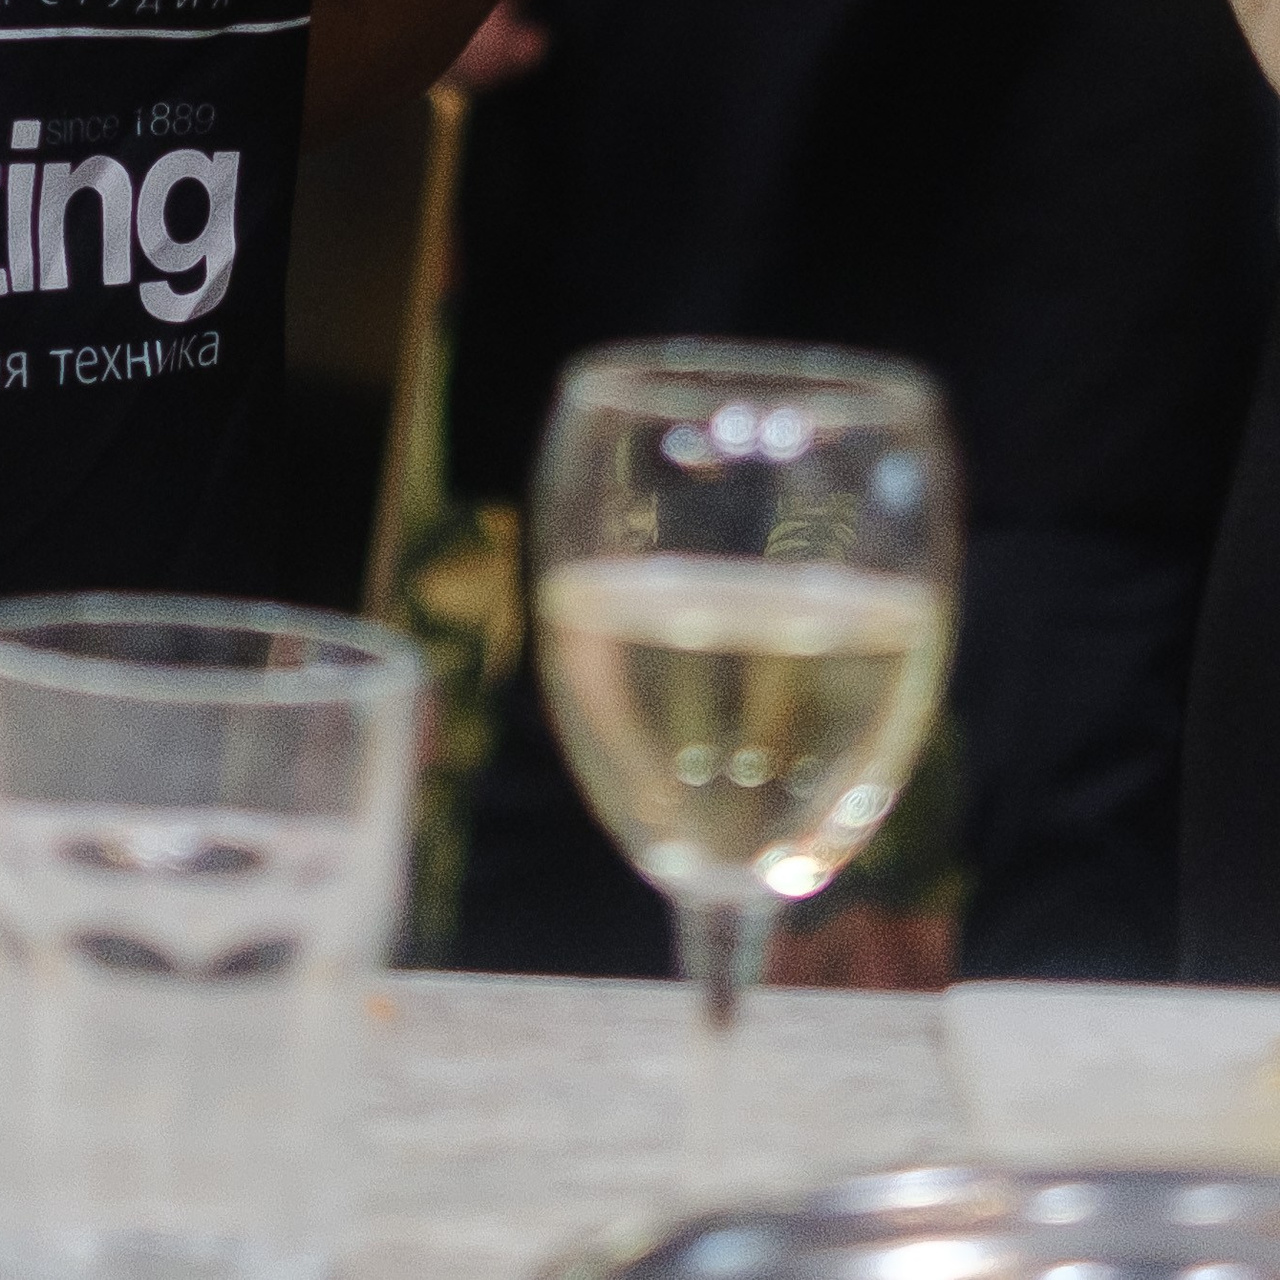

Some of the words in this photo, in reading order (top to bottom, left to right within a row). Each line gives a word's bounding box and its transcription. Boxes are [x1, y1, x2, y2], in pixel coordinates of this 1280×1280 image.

[45, 110, 120, 146] since
[133, 101, 217, 137] 1889
[49, 330, 220, 386] техника
